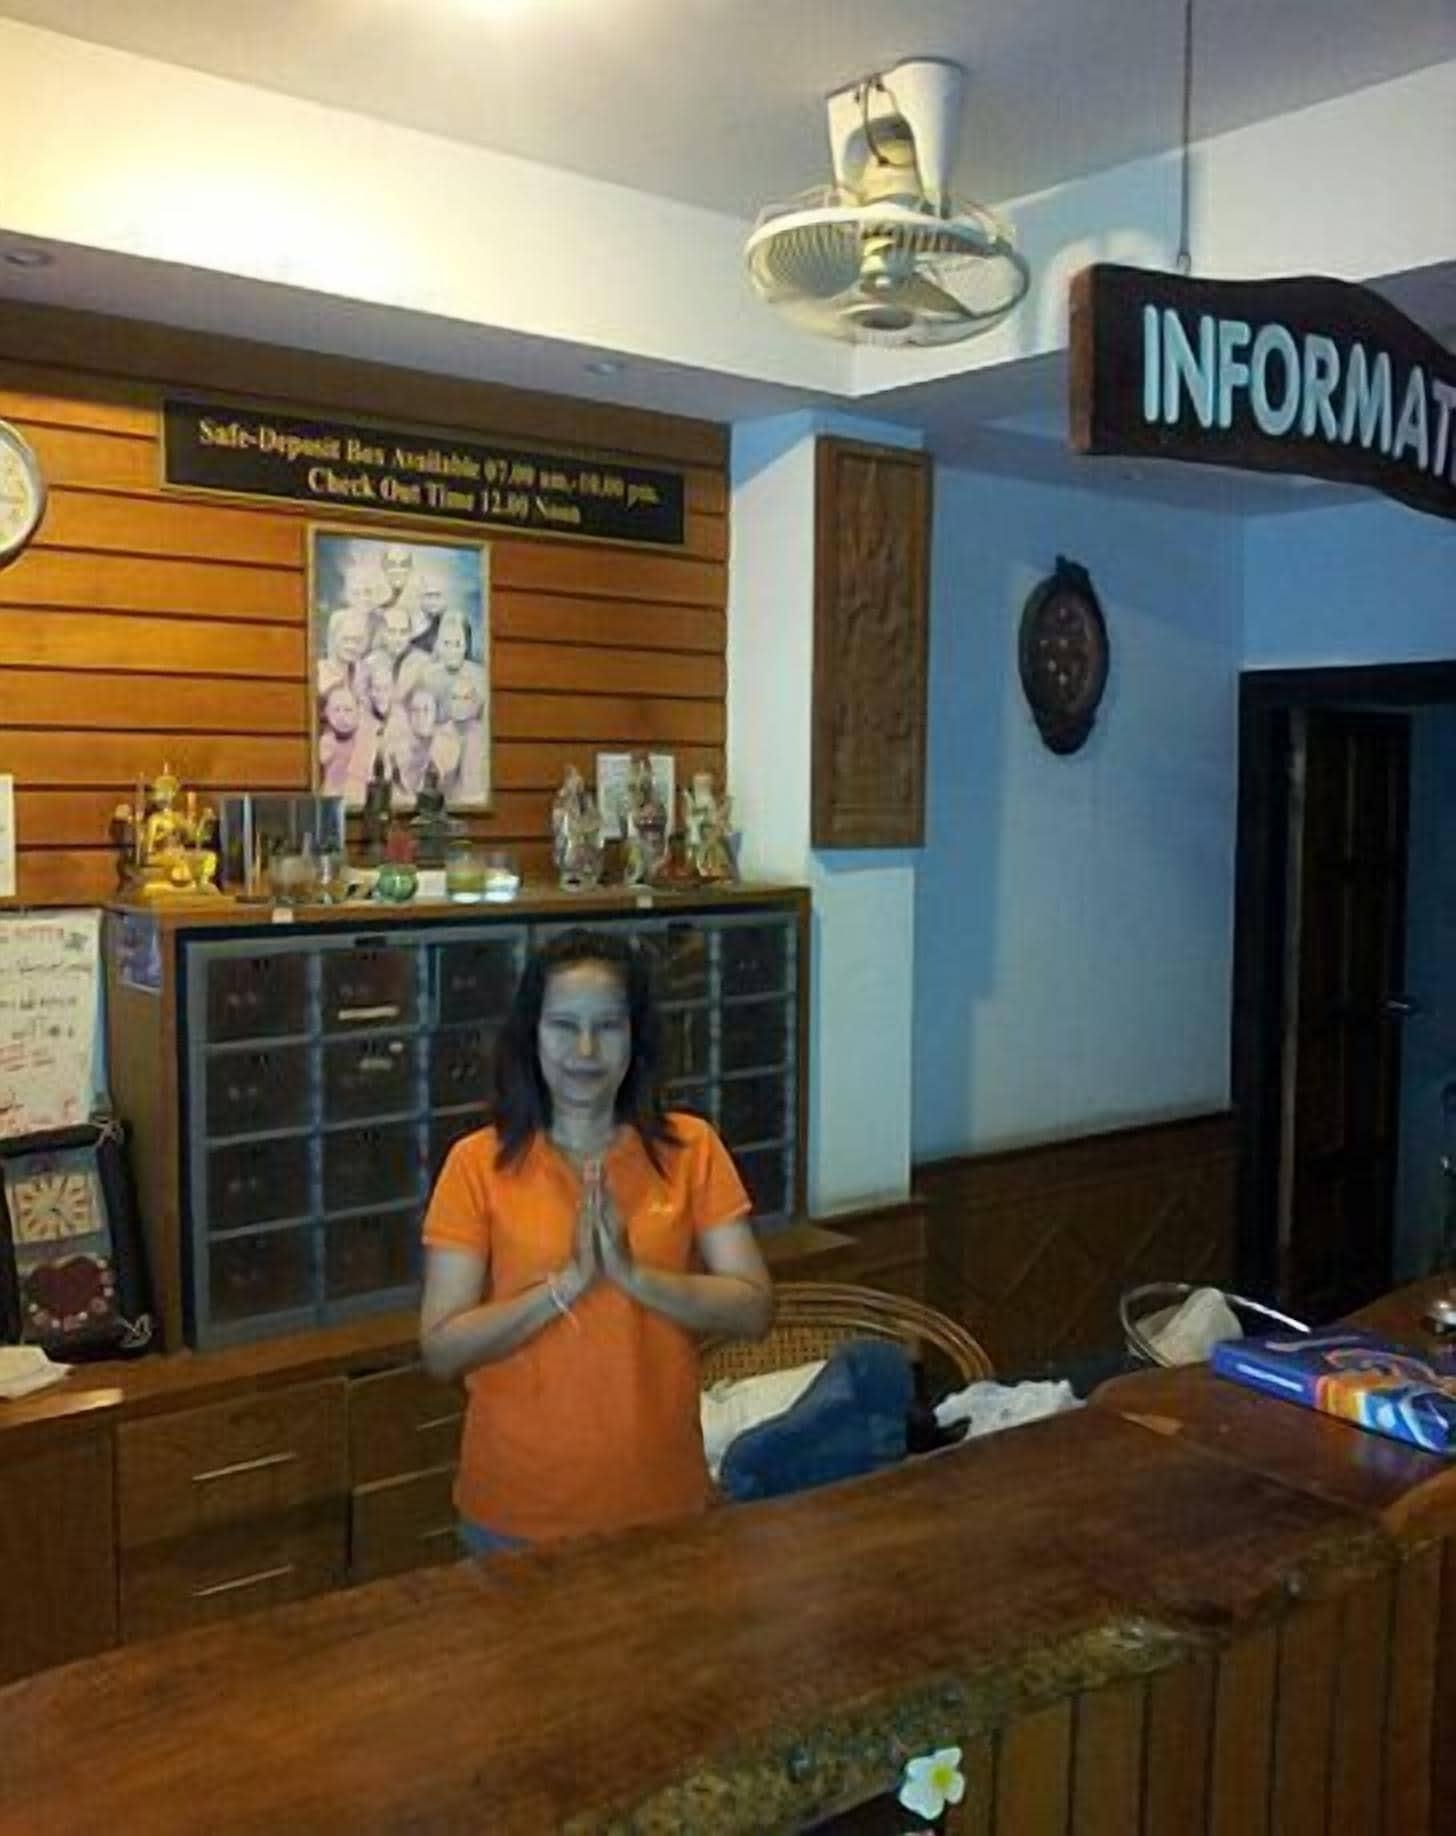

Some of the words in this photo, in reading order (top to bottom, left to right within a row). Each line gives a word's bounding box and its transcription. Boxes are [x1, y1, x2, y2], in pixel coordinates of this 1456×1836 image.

[1143, 304, 1456, 484] INFORMAT
[347, 439, 385, 465] Box
[393, 447, 480, 478] Available
[308, 466, 376, 498] Check
[380, 476, 421, 505] Out
[424, 482, 475, 514] Time
[535, 495, 581, 526] Noon
